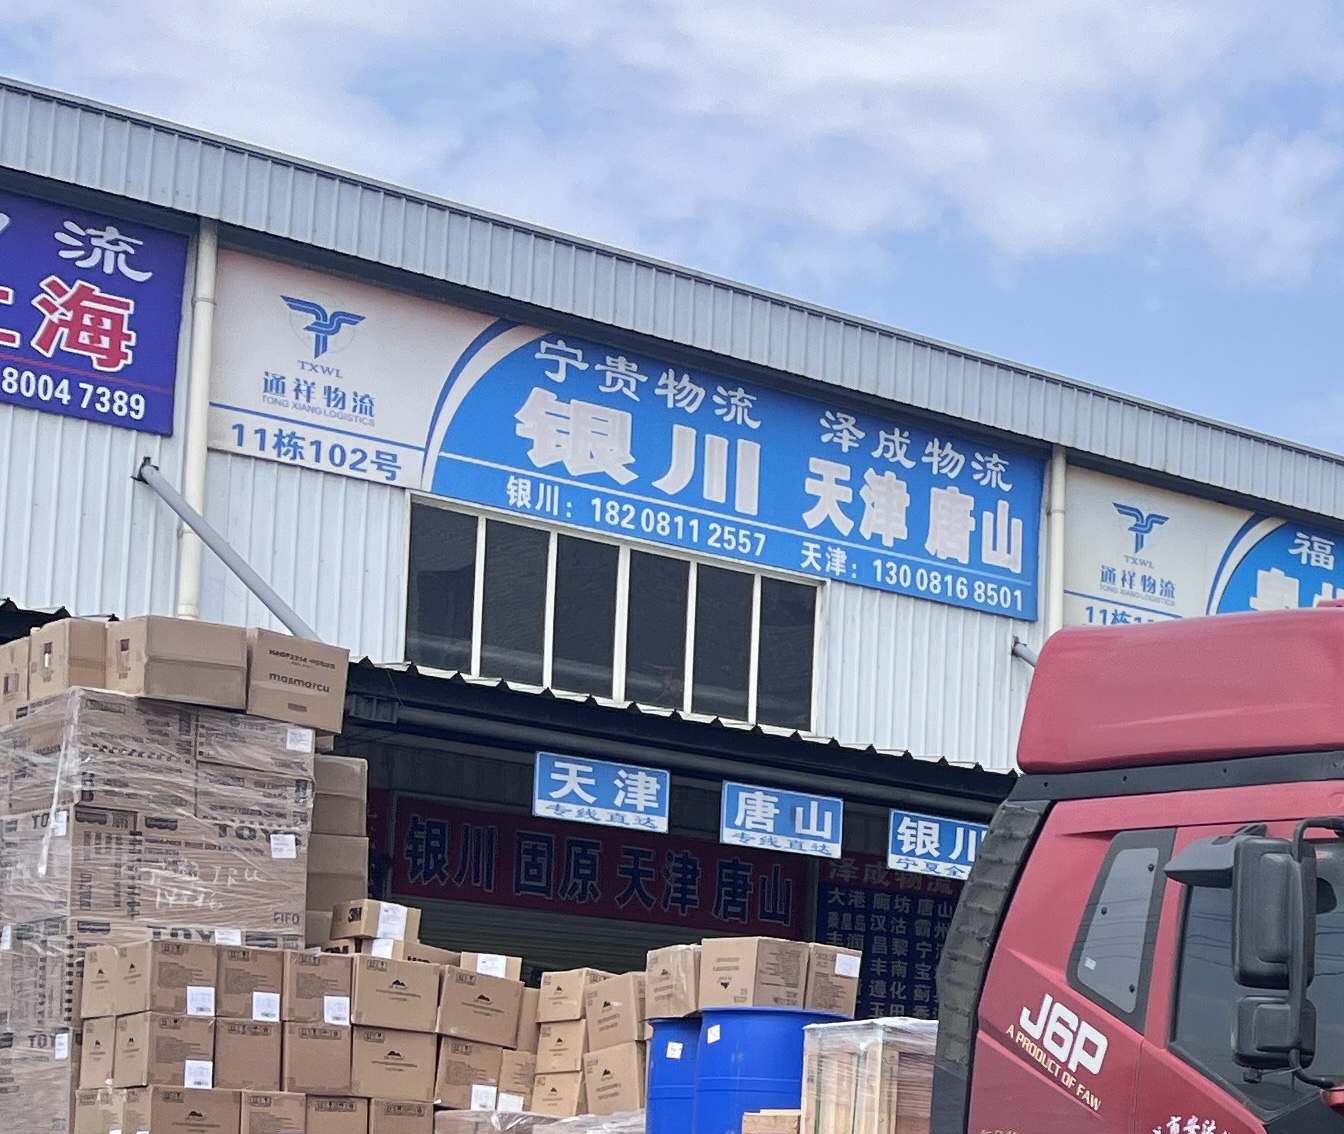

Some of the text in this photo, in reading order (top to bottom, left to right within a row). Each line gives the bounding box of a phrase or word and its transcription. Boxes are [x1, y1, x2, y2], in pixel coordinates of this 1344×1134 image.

[297, 359, 344, 379] TXWL
[78, 382, 146, 420] 7389
[261, 371, 376, 418] 通祥物流
[262, 394, 376, 427] TONG XIANG LOGISTICS
[534, 339, 1013, 492] 宁贵物流 泽成物流
[231, 423, 402, 482] 11栋102号
[513, 386, 1023, 574] 银川 天津 唐山
[591, 496, 636, 531] 182
[640, 508, 699, 543] 0811
[706, 522, 766, 557] 2557
[872, 558, 912, 588] 130
[915, 568, 969, 600] 0816
[973, 580, 1023, 612] 8501
[1100, 565, 1177, 600] 通祥物流
[548, 760, 661, 812] 天津
[545, 803, 659, 829] 专线直达
[734, 791, 833, 839] 唐山
[897, 816, 986, 862] 银川
[348, 906, 363, 923] 3M
[1020, 993, 1108, 1075] J6P
[1015, 1031, 1062, 1078] PRODUCT
[1076, 1083, 1102, 1111] FAW
